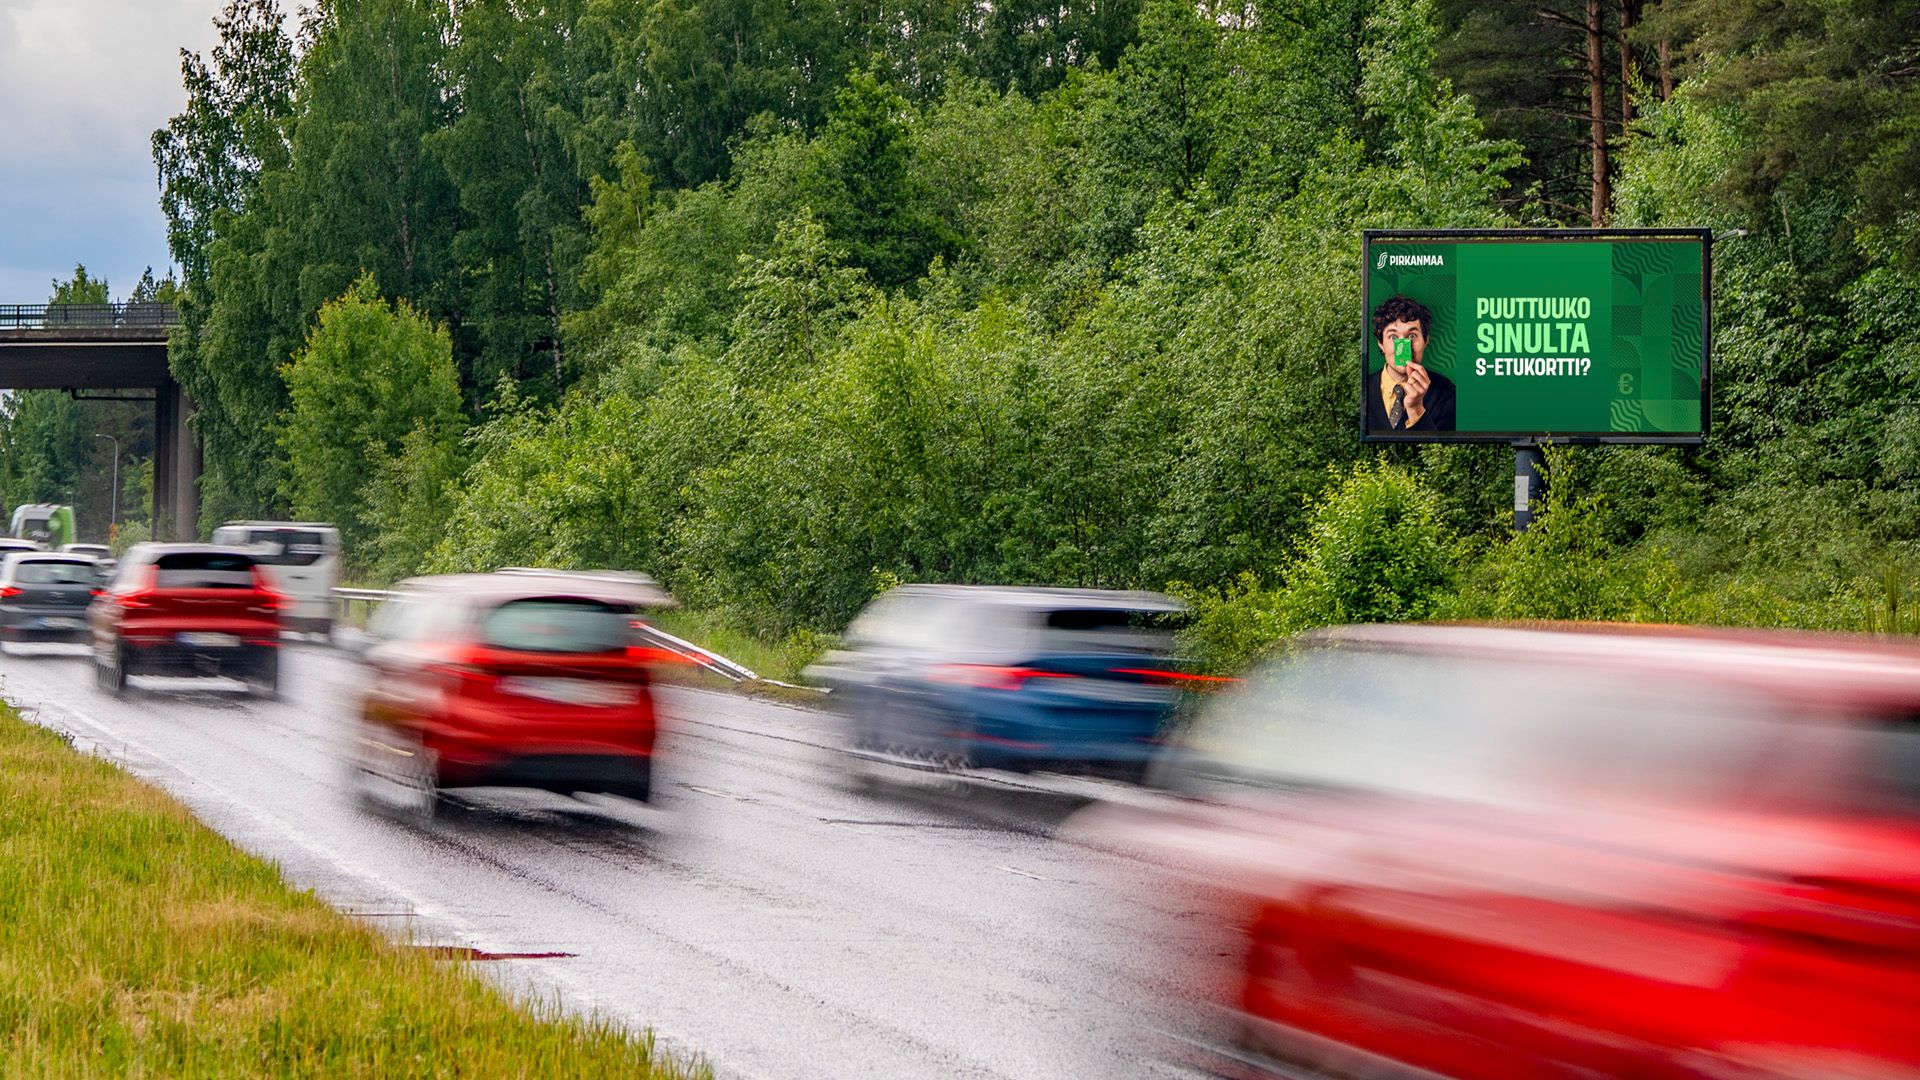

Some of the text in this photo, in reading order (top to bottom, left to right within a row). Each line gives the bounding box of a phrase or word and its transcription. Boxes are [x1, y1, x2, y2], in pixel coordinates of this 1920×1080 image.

[1389, 255, 1444, 266] PIRKANMAA
[1476, 297, 1590, 319] PUUTTUUKO
[1476, 323, 1590, 354] SINULTA
[1475, 358, 1591, 377] S-ETUKORTTI?
